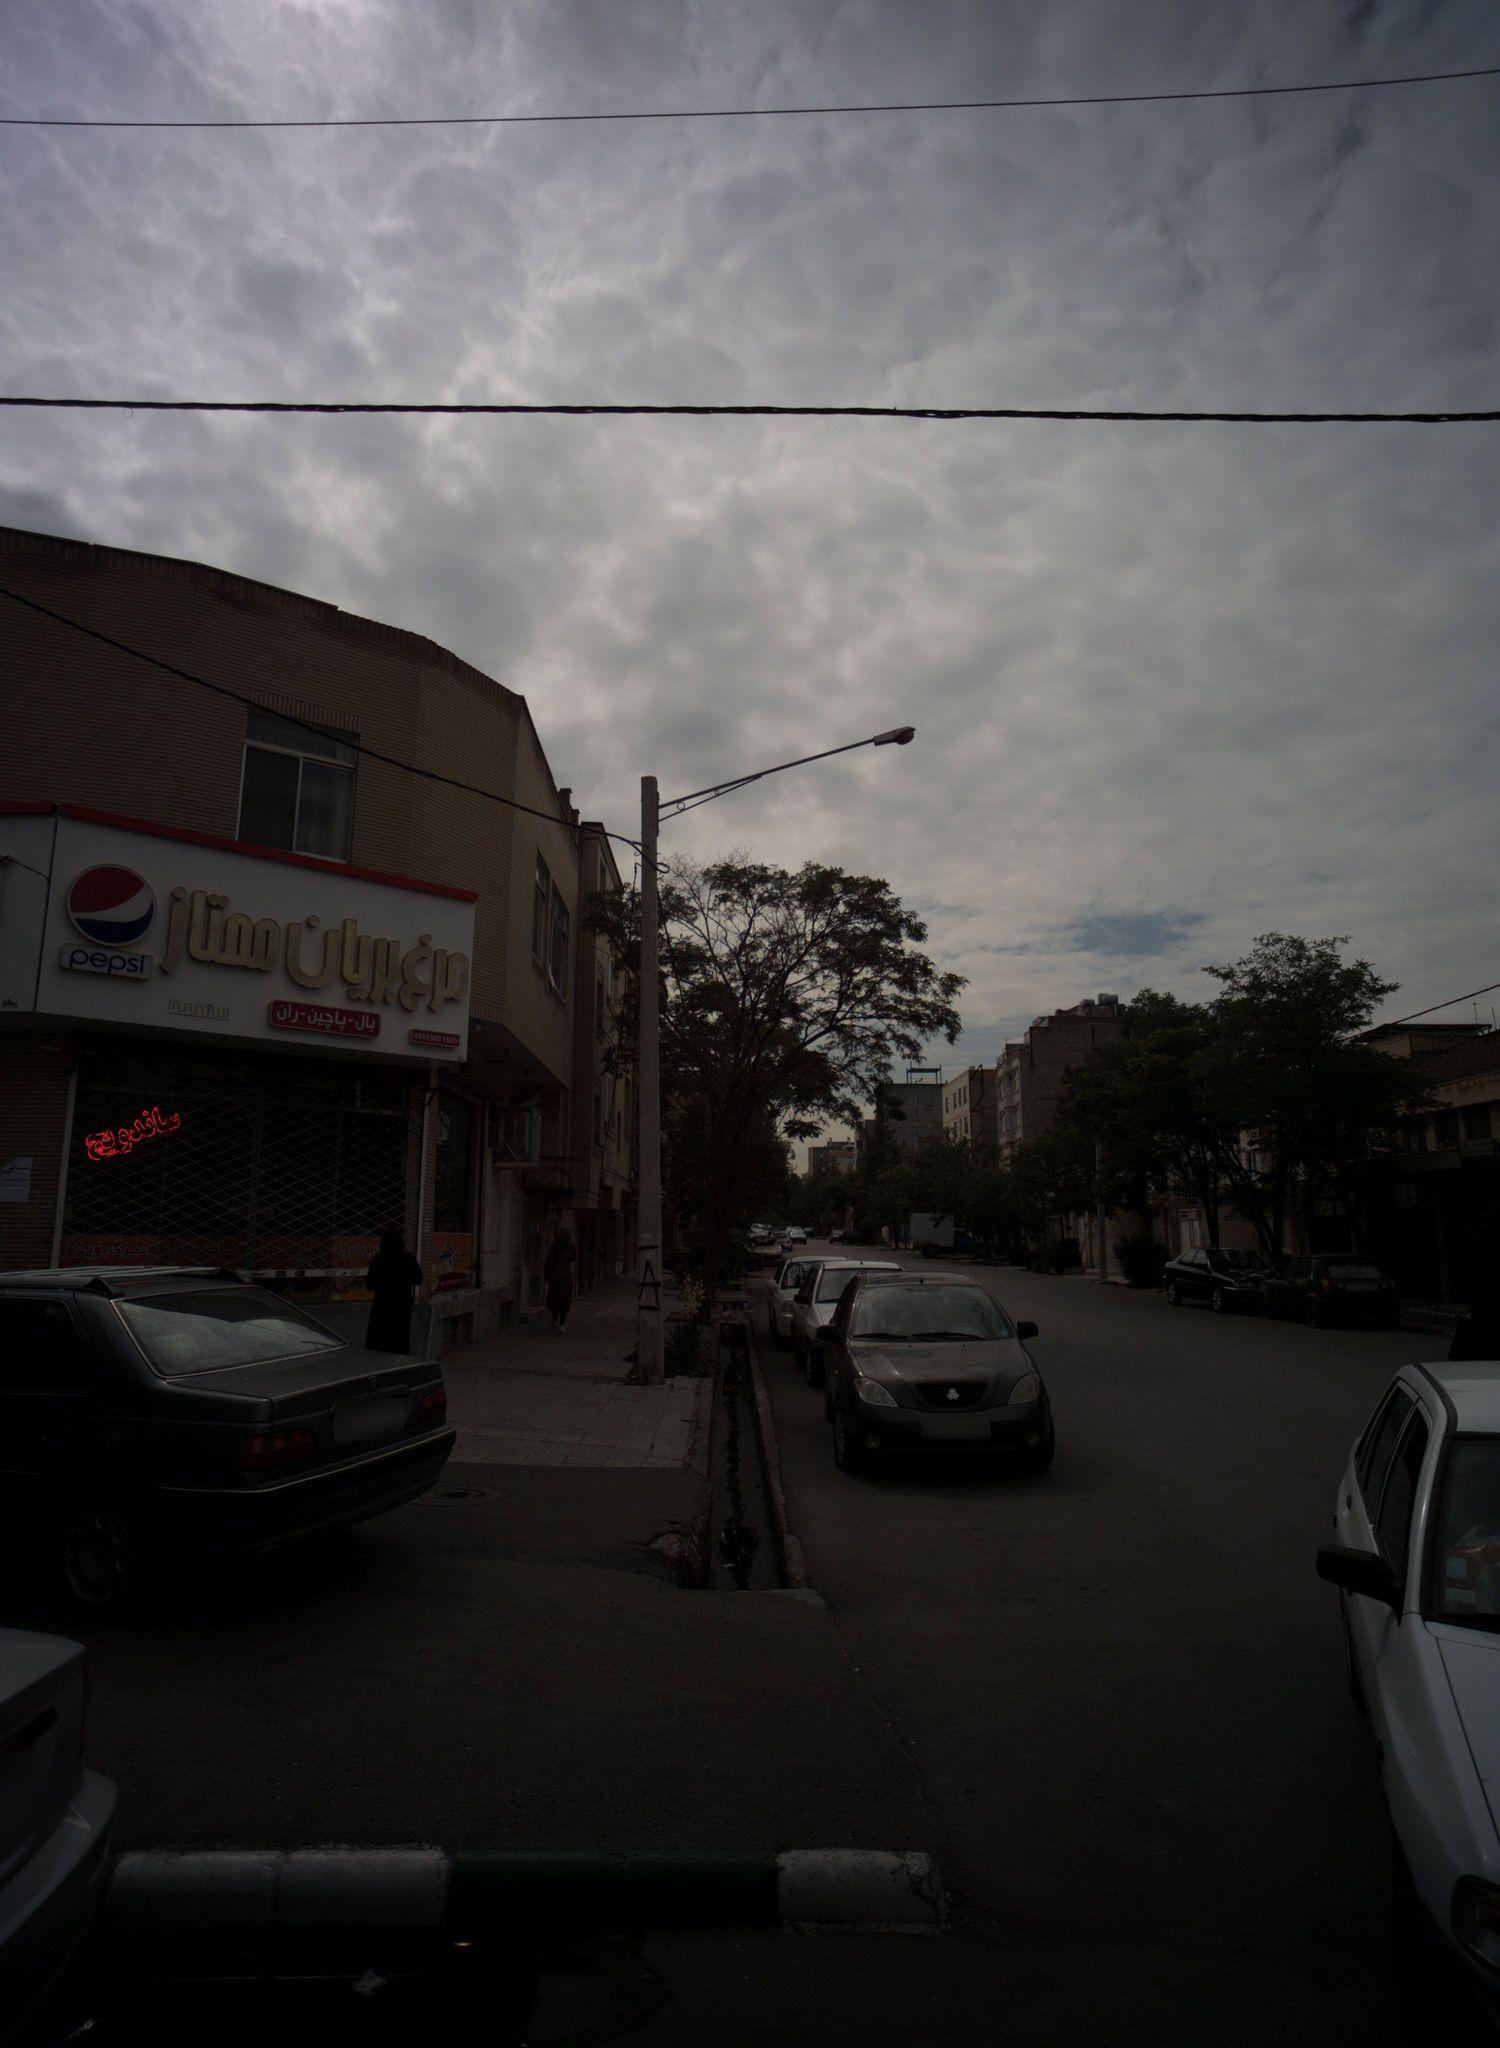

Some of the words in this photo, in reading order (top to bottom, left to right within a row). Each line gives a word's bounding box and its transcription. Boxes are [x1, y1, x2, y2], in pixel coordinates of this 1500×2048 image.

[69, 949, 145, 973] pepsi
[159, 886, 281, 975] ممتاز
[285, 915, 400, 1005] بریان
[398, 933, 471, 1013] مرغ
